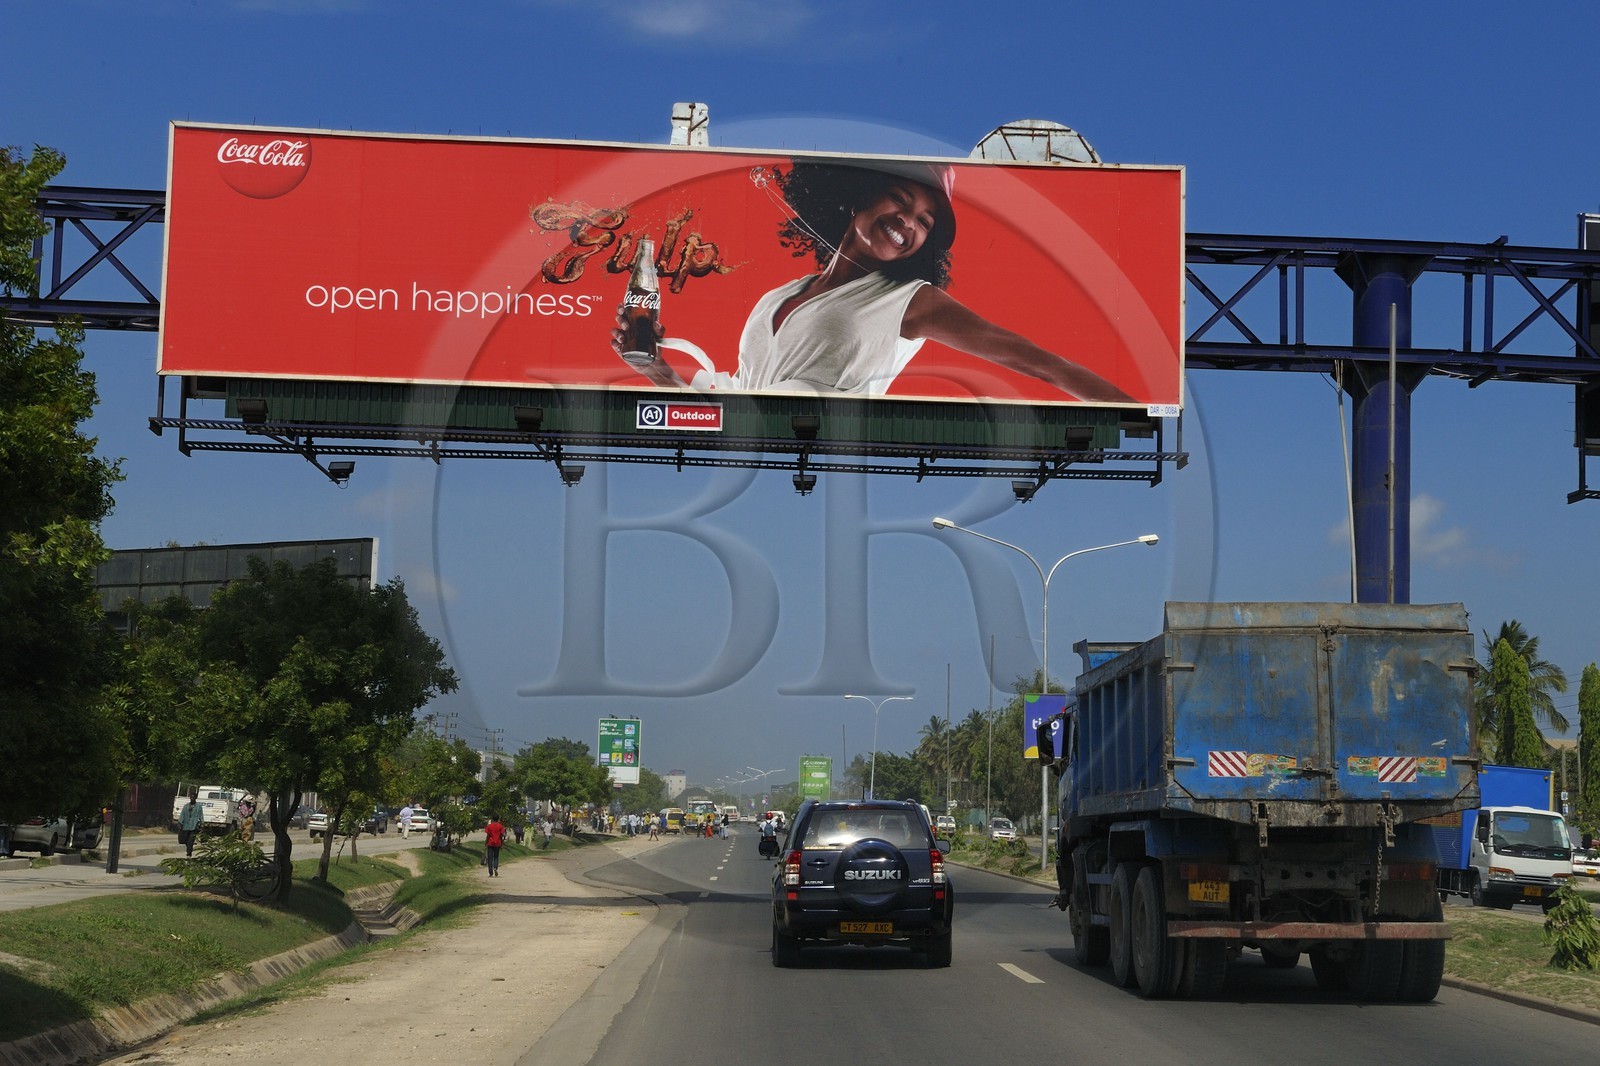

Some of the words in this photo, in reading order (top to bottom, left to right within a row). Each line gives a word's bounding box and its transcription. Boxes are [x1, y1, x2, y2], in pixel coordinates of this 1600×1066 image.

[217, 138, 308, 166] Coca-Cola
[305, 285, 399, 314] open
[671, 410, 717, 421] Outdoor
[1032, 717, 1060, 737] tio
[844, 870, 902, 880] SUZUKI
[1203, 891, 1220, 900] AUT
[853, 923, 868, 932] 527
[874, 924, 889, 933] AXC
